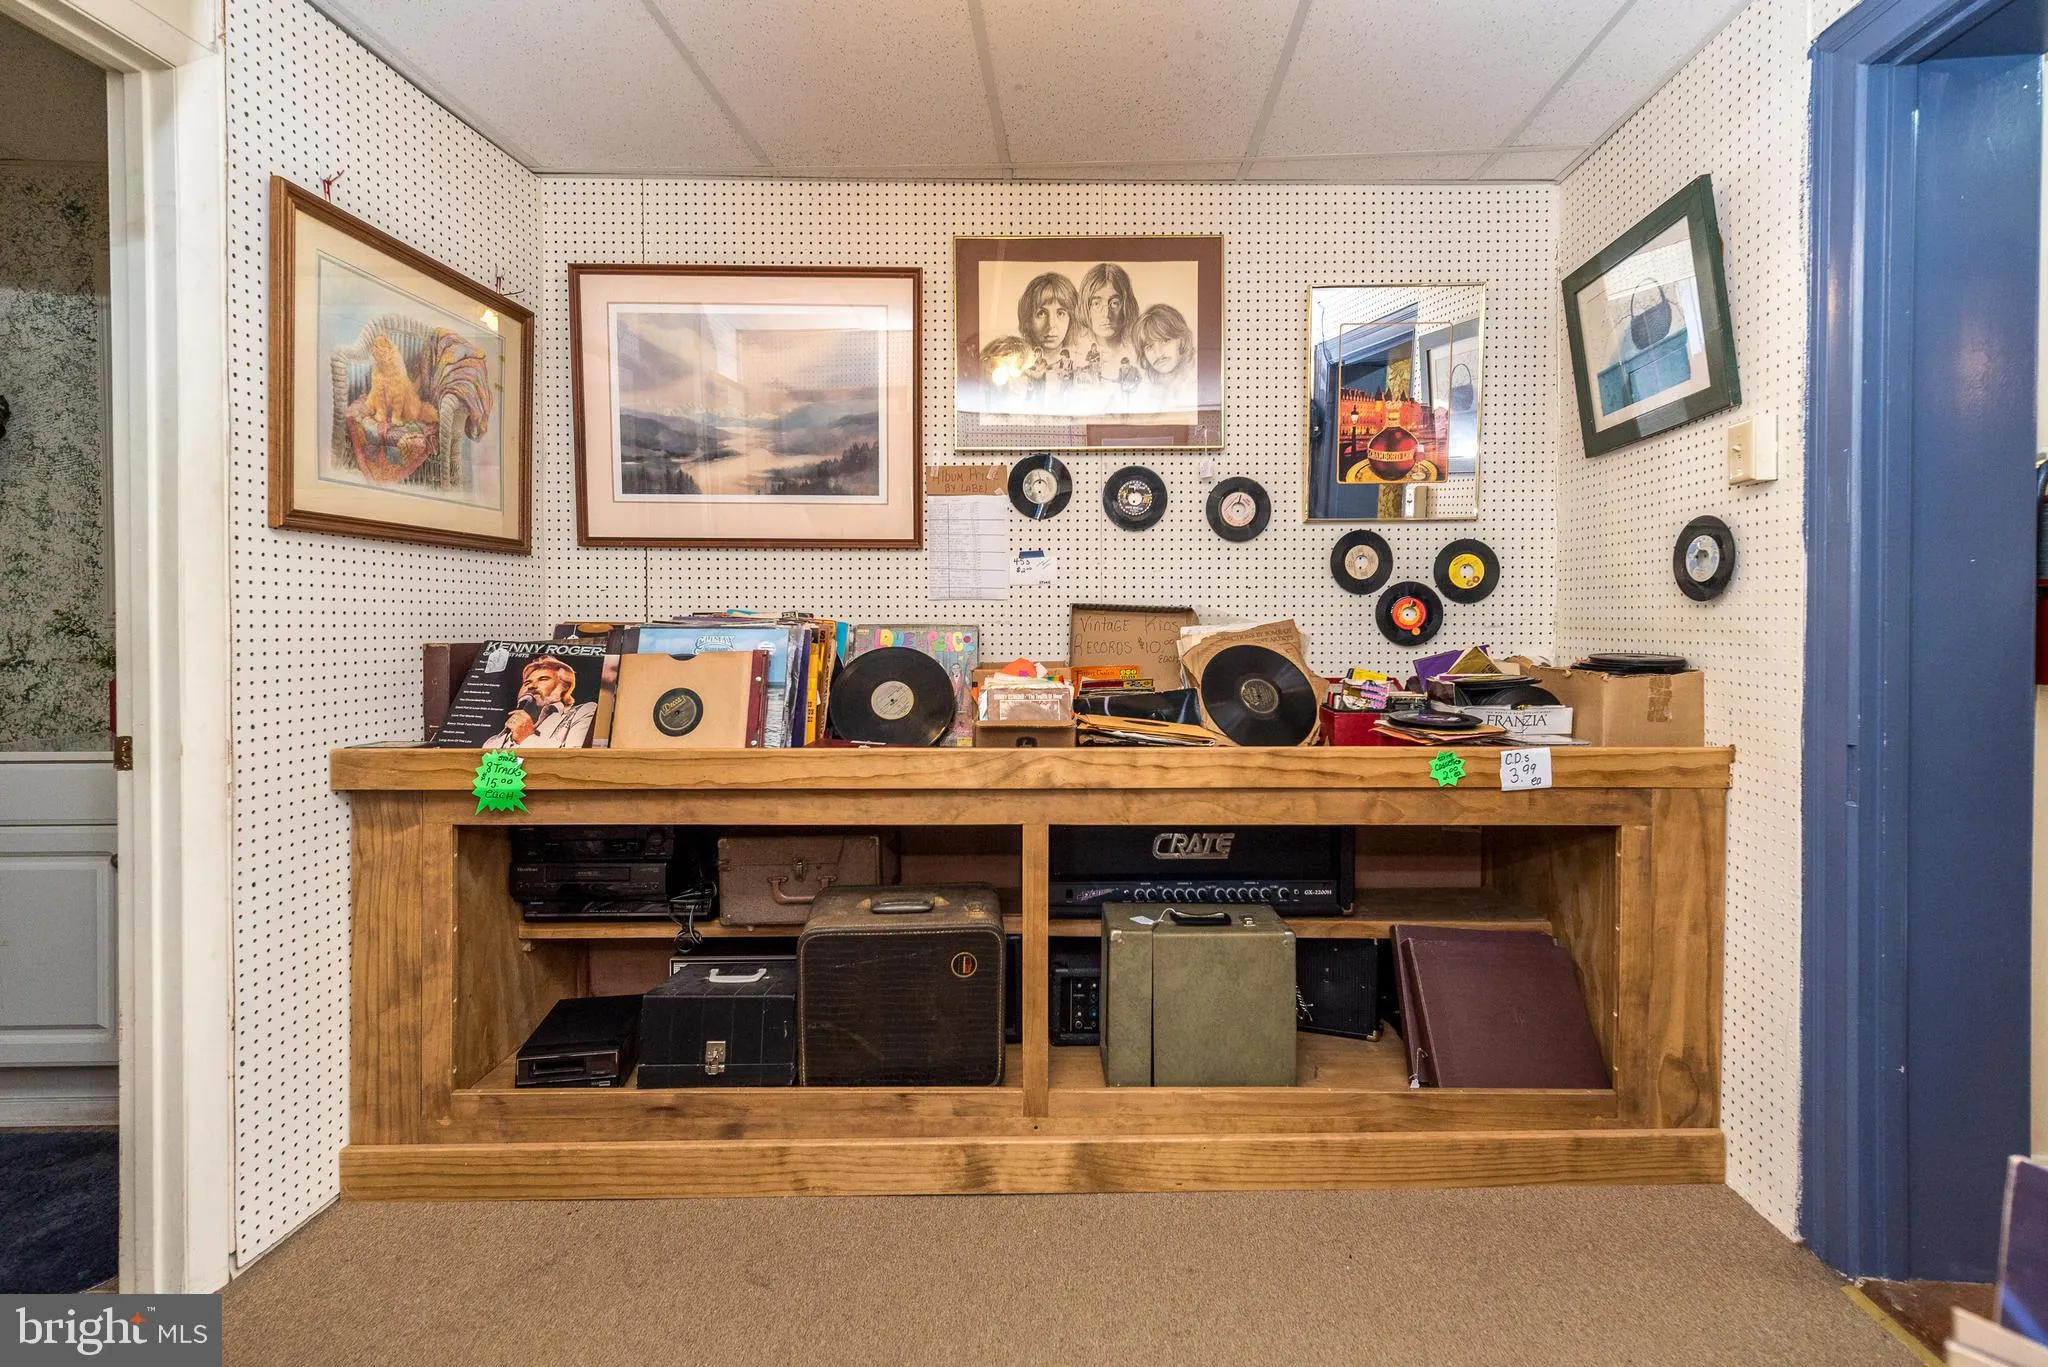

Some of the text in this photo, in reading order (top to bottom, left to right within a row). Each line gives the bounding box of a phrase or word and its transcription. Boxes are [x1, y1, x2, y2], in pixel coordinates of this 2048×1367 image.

[486, 641, 545, 653] KENNY
[1487, 714, 1547, 729] FRANZIA
[1152, 833, 1235, 860] CRATE
